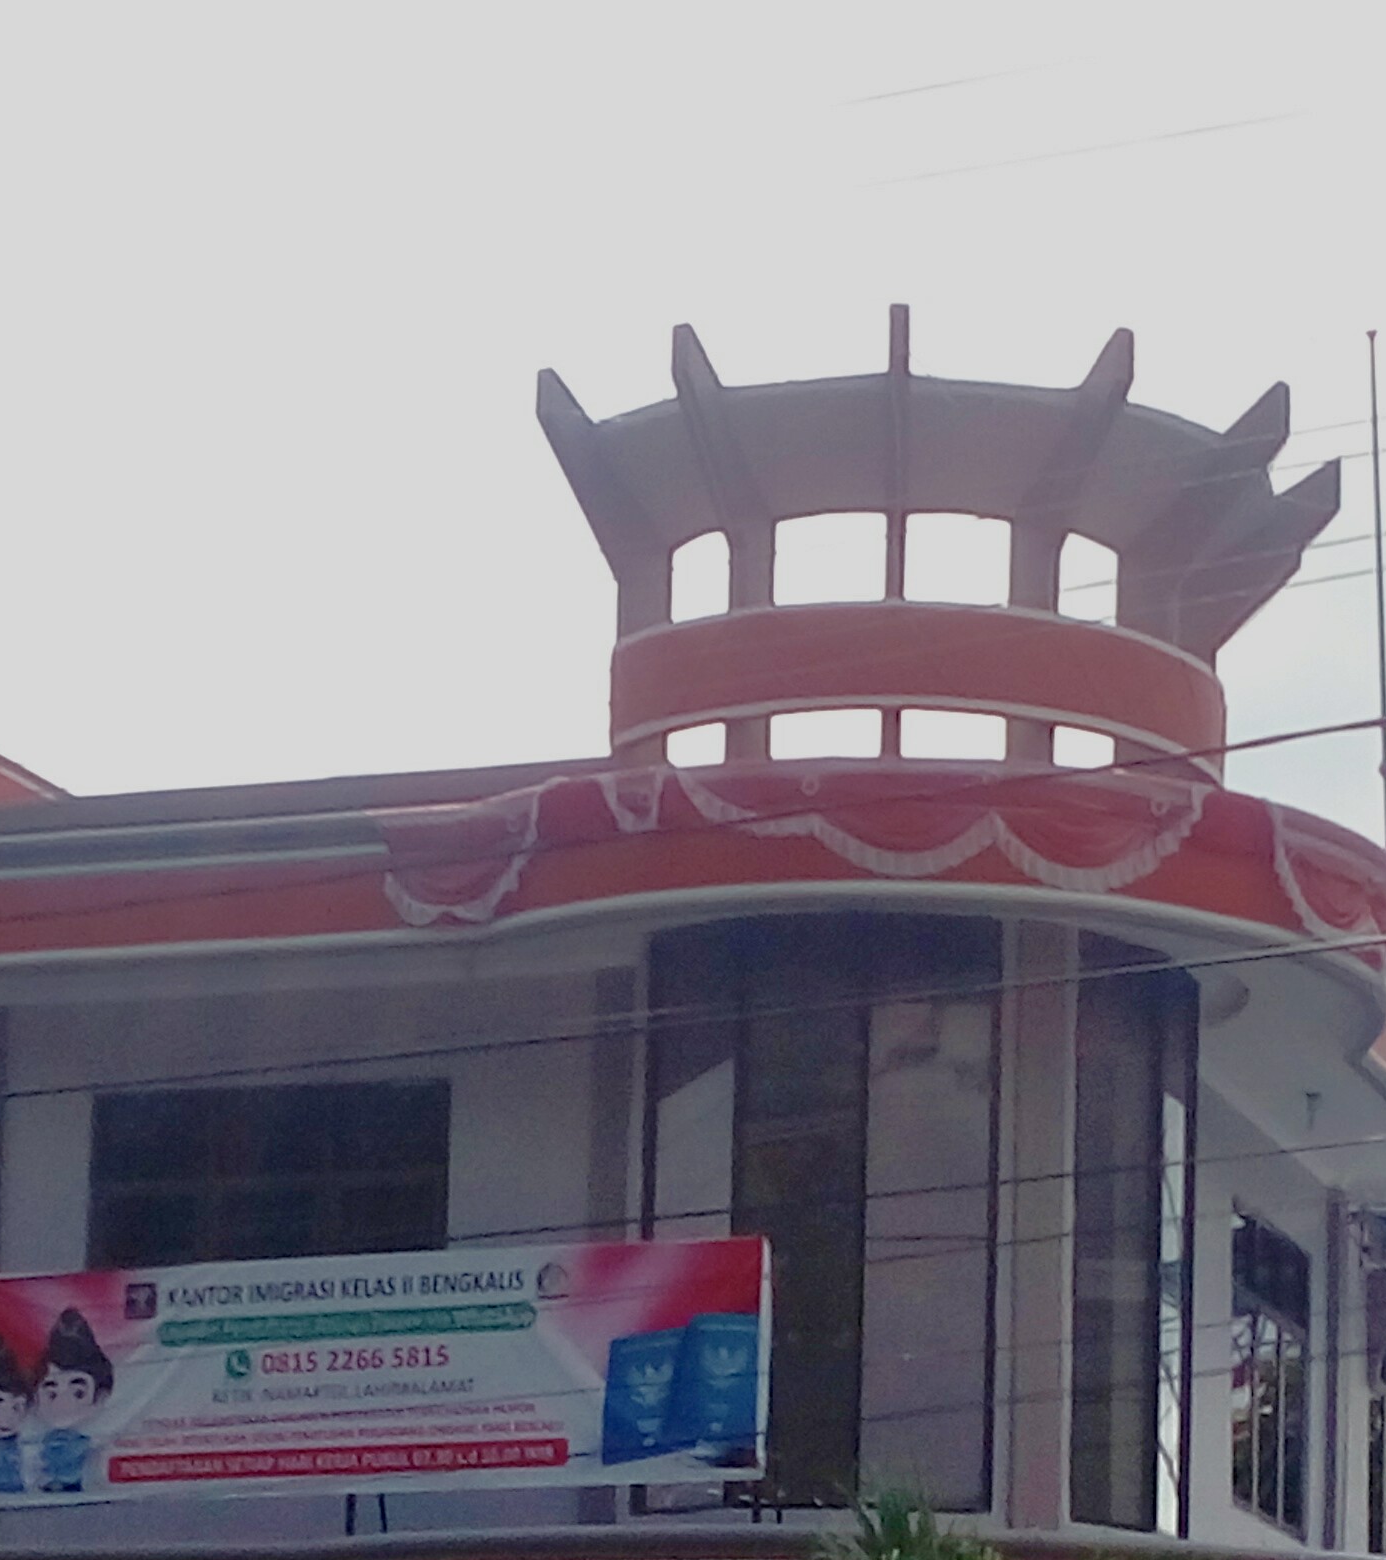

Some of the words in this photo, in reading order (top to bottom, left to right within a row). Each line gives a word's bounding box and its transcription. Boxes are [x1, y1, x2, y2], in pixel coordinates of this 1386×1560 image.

[167, 1285, 244, 1307] KANTOR
[249, 1280, 335, 1304] IMIGRASI
[341, 1277, 396, 1300] KELAS
[419, 1269, 525, 1296] BENGKALIS
[261, 1350, 318, 1375] 0815
[326, 1348, 384, 1372] 2266
[390, 1344, 450, 1369] 5815
